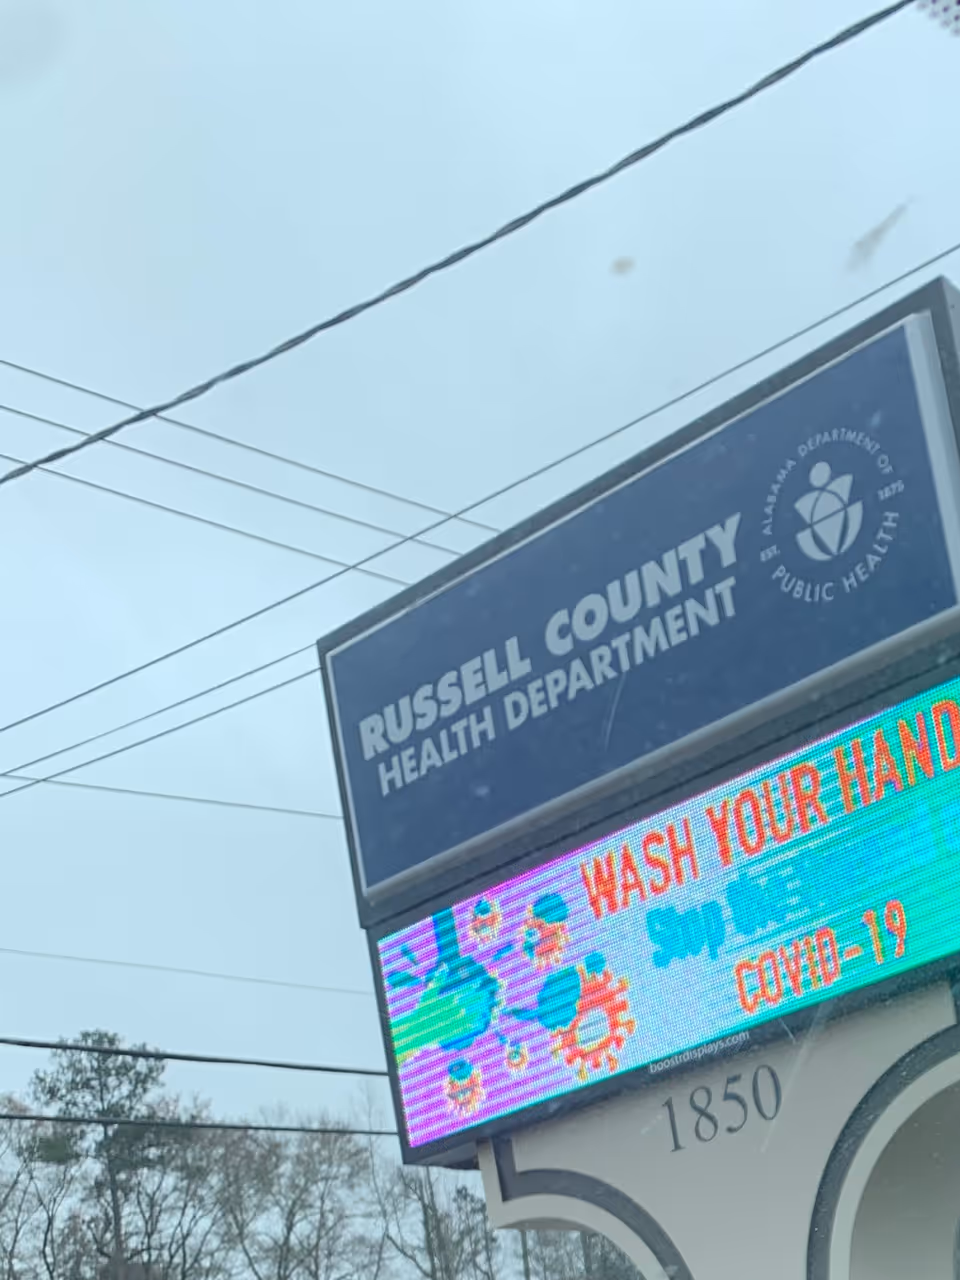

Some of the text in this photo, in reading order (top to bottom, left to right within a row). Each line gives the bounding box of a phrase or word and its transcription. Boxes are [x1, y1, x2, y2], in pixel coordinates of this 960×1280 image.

[762, 428, 894, 535] ALABAMA DEPARTMENT OF
[771, 511, 899, 602] PUBLIC HEALTH
[359, 512, 741, 761] RUSSELL COUNTY
[378, 576, 736, 797] HEALTH DEPARTMENT
[579, 817, 699, 921] WASH
[705, 762, 829, 867] YOUR
[734, 899, 907, 1014] COVID-19
[650, 1031, 750, 1075] boostrdisplays.com
[662, 1064, 782, 1152] 1850
